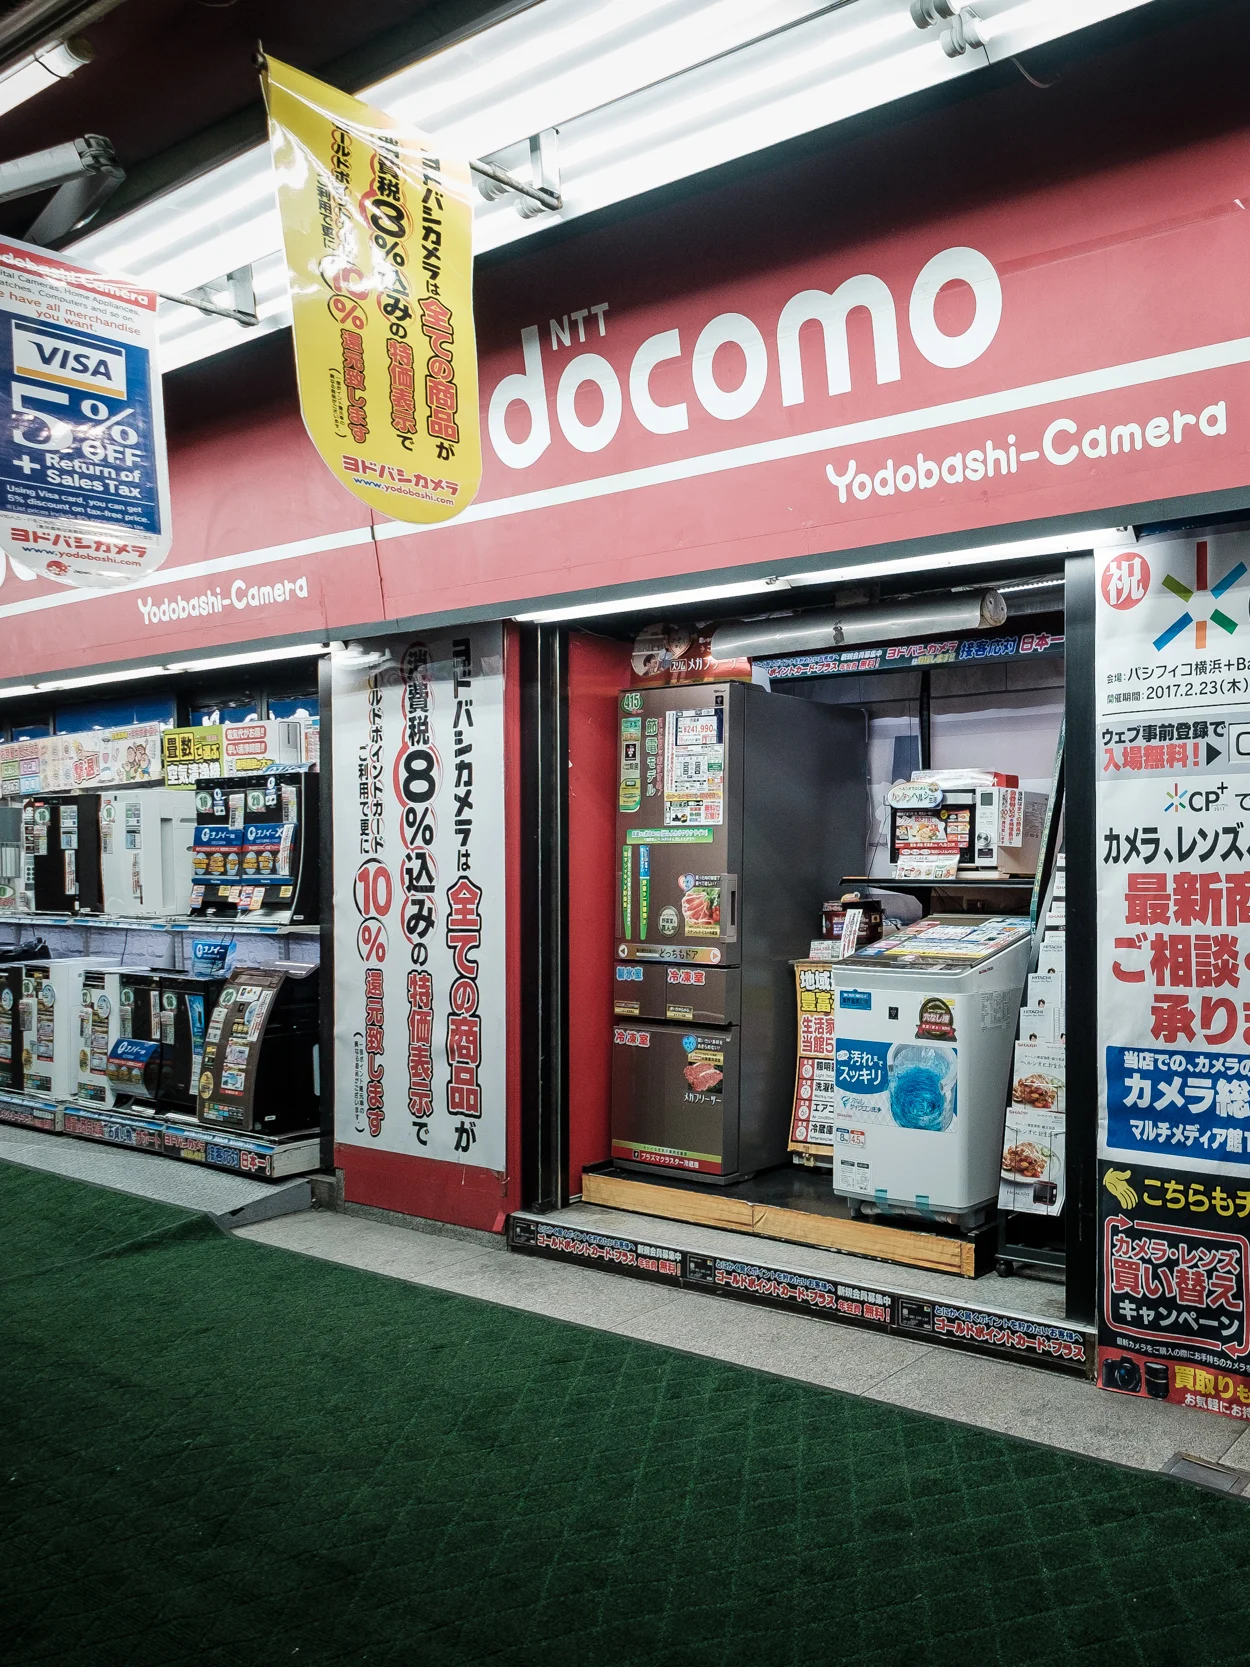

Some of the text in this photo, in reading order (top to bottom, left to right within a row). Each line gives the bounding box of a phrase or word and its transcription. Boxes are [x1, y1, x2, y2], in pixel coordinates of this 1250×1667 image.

[10, 292, 141, 336] have all merchandise
[36, 309, 60, 321] you
[550, 302, 610, 352] NTT
[28, 339, 113, 382] VISA
[486, 246, 1003, 470] docomo
[45, 453, 141, 482] Return of
[82, 440, 142, 467] OFF
[826, 401, 1228, 505] Yodobashi-Camera
[46, 470, 142, 498] Sales Tax
[342, 454, 460, 496] ヨドバシカメラ
[6, 485, 142, 514] Using Visa card, you can get
[353, 476, 455, 506] www.yodobashi.com
[7, 494, 25, 503] 5%
[27, 498, 69, 511] discount
[72, 505, 84, 513] on
[87, 508, 122, 519] tax-free
[11, 527, 148, 558] ヨドバシカメラ
[22, 546, 141, 567] www.yodobashi.com
[1106, 556, 1146, 606] 祝
[137, 575, 308, 625] Yodobashi-Camera
[1101, 720, 1227, 746] ウェブ事前登録で
[1103, 742, 1200, 772] 入場無料!
[668, 970, 705, 985] 冷凍室
[839, 1066, 882, 1086] スッキリ
[1112, 1234, 1240, 1275] カメラ・レンズ
[715, 1270, 890, 1322] ゴールドポイントカード・プラス 年会費 無料!
[837, 1285, 891, 1306] 新規会員募集中
[1111, 1256, 1243, 1312] 買い替え
[1118, 1300, 1240, 1337] キャンペーン
